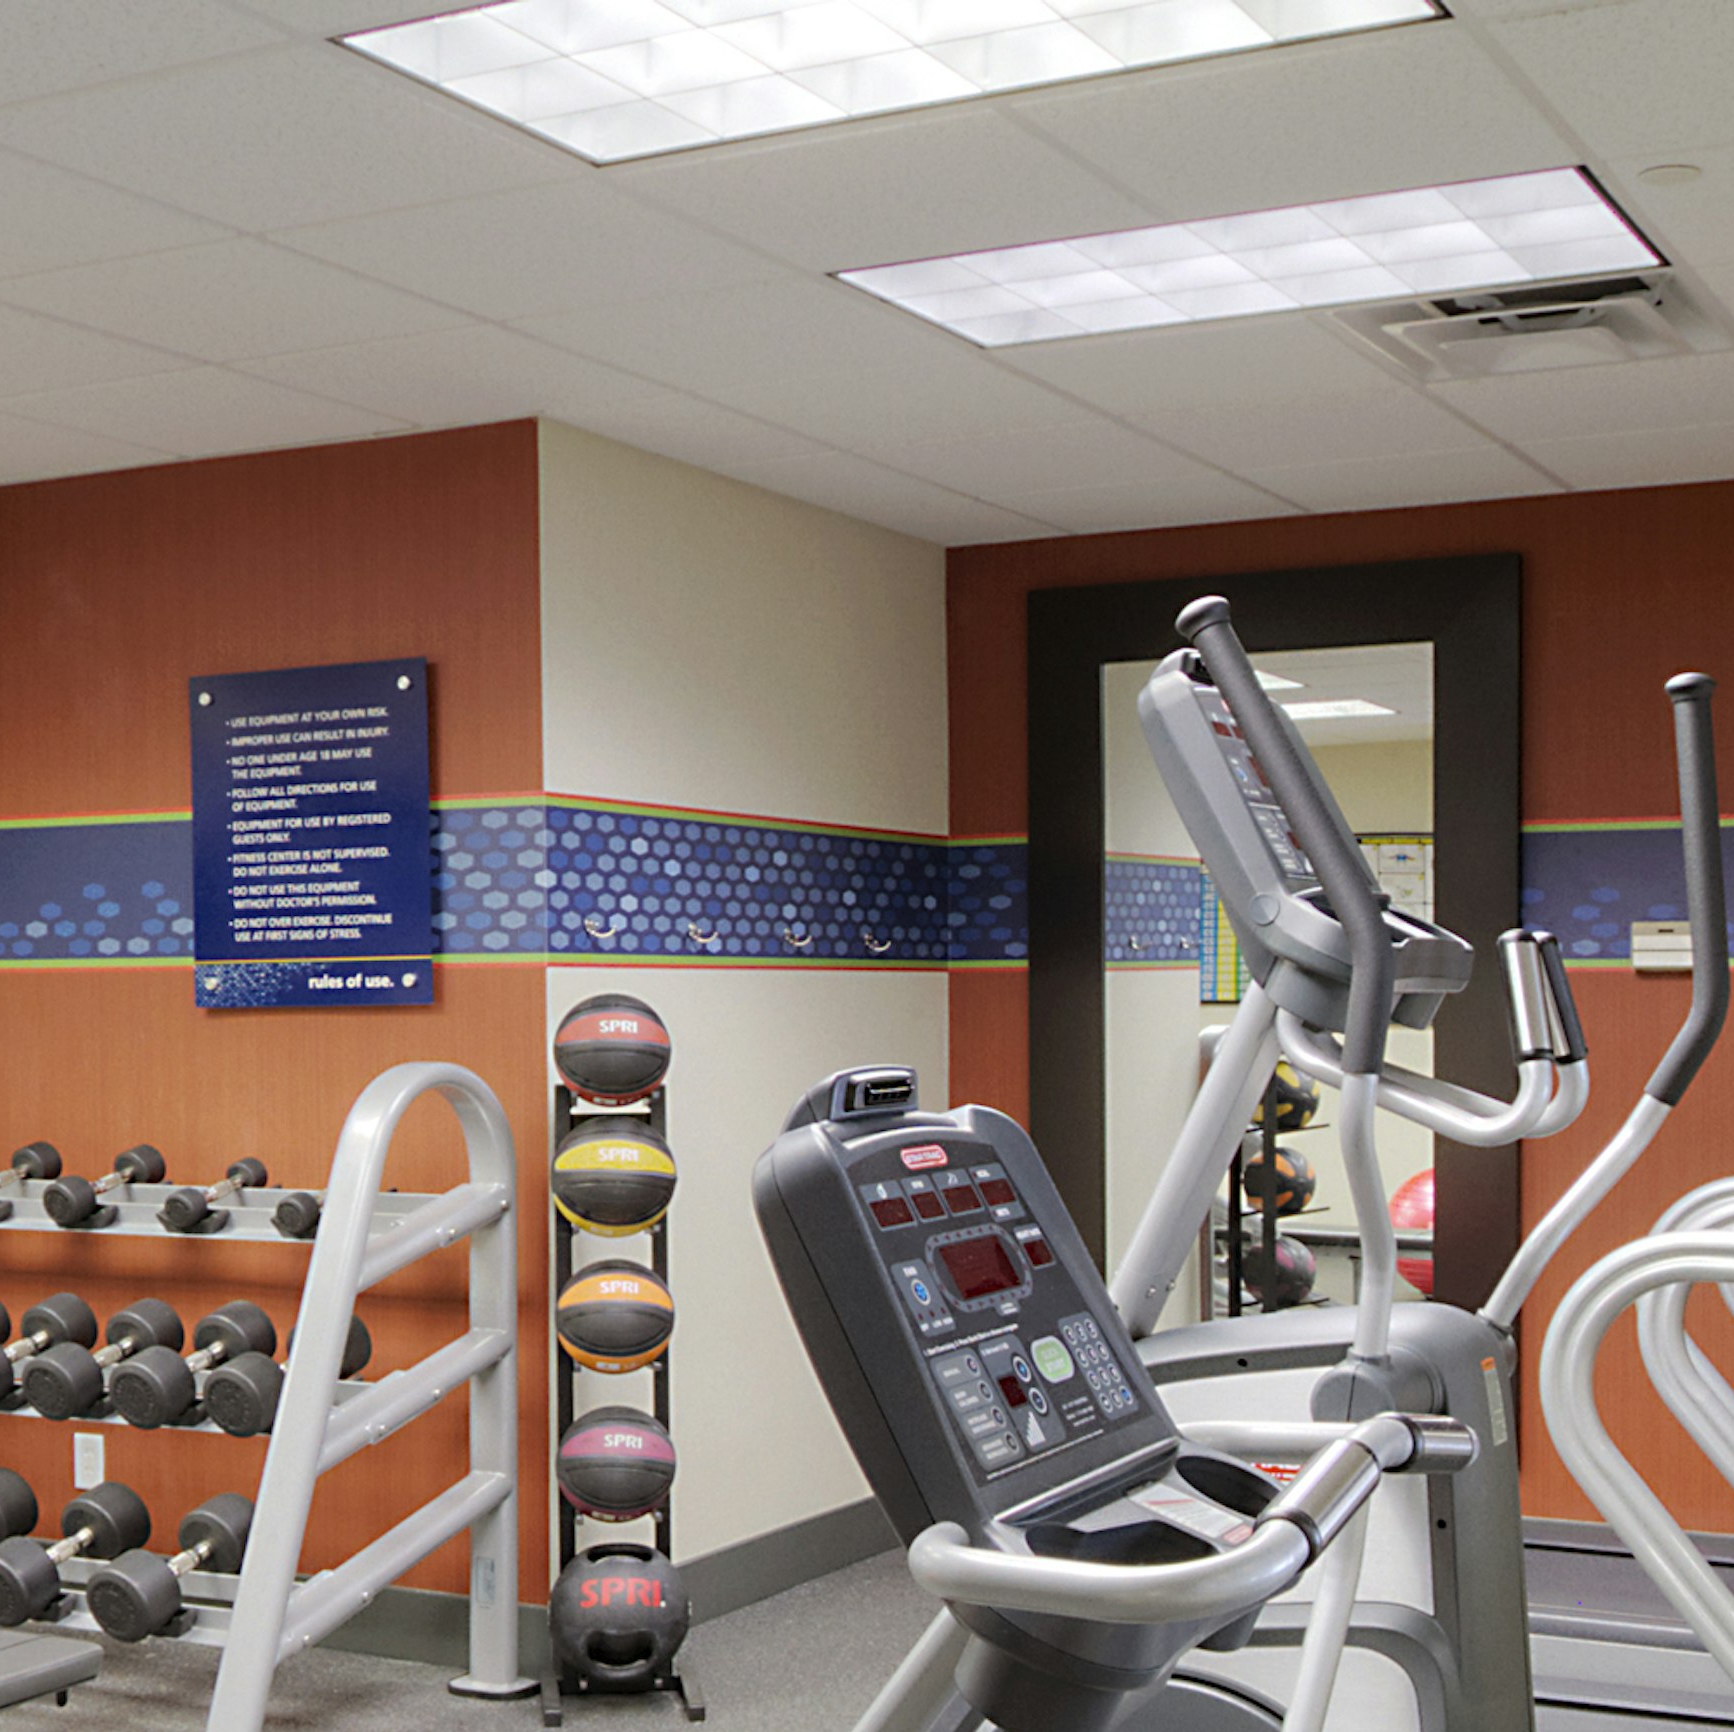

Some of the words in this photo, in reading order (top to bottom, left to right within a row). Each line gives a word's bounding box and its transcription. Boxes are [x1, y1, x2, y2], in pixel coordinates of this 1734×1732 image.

[231, 716, 247, 728] USE
[248, 713, 299, 727] EQUIPMENT
[301, 711, 312, 722] AT
[314, 709, 340, 721] YOUR
[341, 708, 366, 720] OWN
[231, 734, 274, 747] IMPROPER
[275, 732, 291, 744] USE
[292, 731, 312, 743] CAN
[313, 729, 344, 741] RESULT
[346, 728, 355, 739] IN
[231, 755, 245, 766] NO
[247, 754, 265, 766] ONE
[267, 752, 298, 764] UNDER
[299, 750, 318, 762] AGE
[332, 748, 353, 760] MAY
[355, 746, 372, 758] USE
[232, 768, 248, 779] THE
[232, 787, 269, 799] FOLLOW
[269, 785, 286, 797] ALL
[287, 783, 339, 796] DIRECTIONS
[340, 781, 358, 793] FOR
[359, 780, 377, 792] USE
[231, 801, 244, 813] OF
[232, 818, 283, 833] EQUIPMENT
[285, 817, 303, 829] FOR
[304, 815, 321, 828] USE
[322, 815, 336, 827] BY
[337, 811, 392, 826] REGISTERED
[232, 833, 265, 845] GUESTS
[233, 852, 266, 864] FITNESS
[267, 850, 301, 862] CENTER
[303, 850, 311, 861] IS
[312, 848, 332, 861] NOT
[233, 866, 247, 878] DO
[248, 864, 267, 877] NOT
[268, 863, 308, 876] EXERCISE
[233, 885, 248, 897] DO
[248, 884, 268, 896] NOT
[269, 884, 286, 896] USE
[287, 883, 306, 895] THIS
[308, 881, 361, 894] EQUIPMENT
[233, 898, 275, 910] WITHOUT
[234, 917, 248, 929] DO
[248, 917, 267, 928] NOT
[268, 915, 292, 928] OVER
[334, 912, 392, 925] DISCONTINUE
[235, 930, 251, 942] USE
[252, 930, 264, 941] AT
[265, 929, 288, 941] FIRST
[289, 928, 315, 940] SIGNS
[315, 927, 328, 940] OF
[308, 973, 344, 989] rules
[346, 972, 363, 989] of
[364, 975, 395, 988] use.
[599, 1019, 639, 1034] SPRI
[598, 1148, 639, 1163] SPRI
[599, 1280, 639, 1295] SPRI
[604, 1434, 643, 1449] SPRI
[579, 1577, 662, 1608] SPRI
